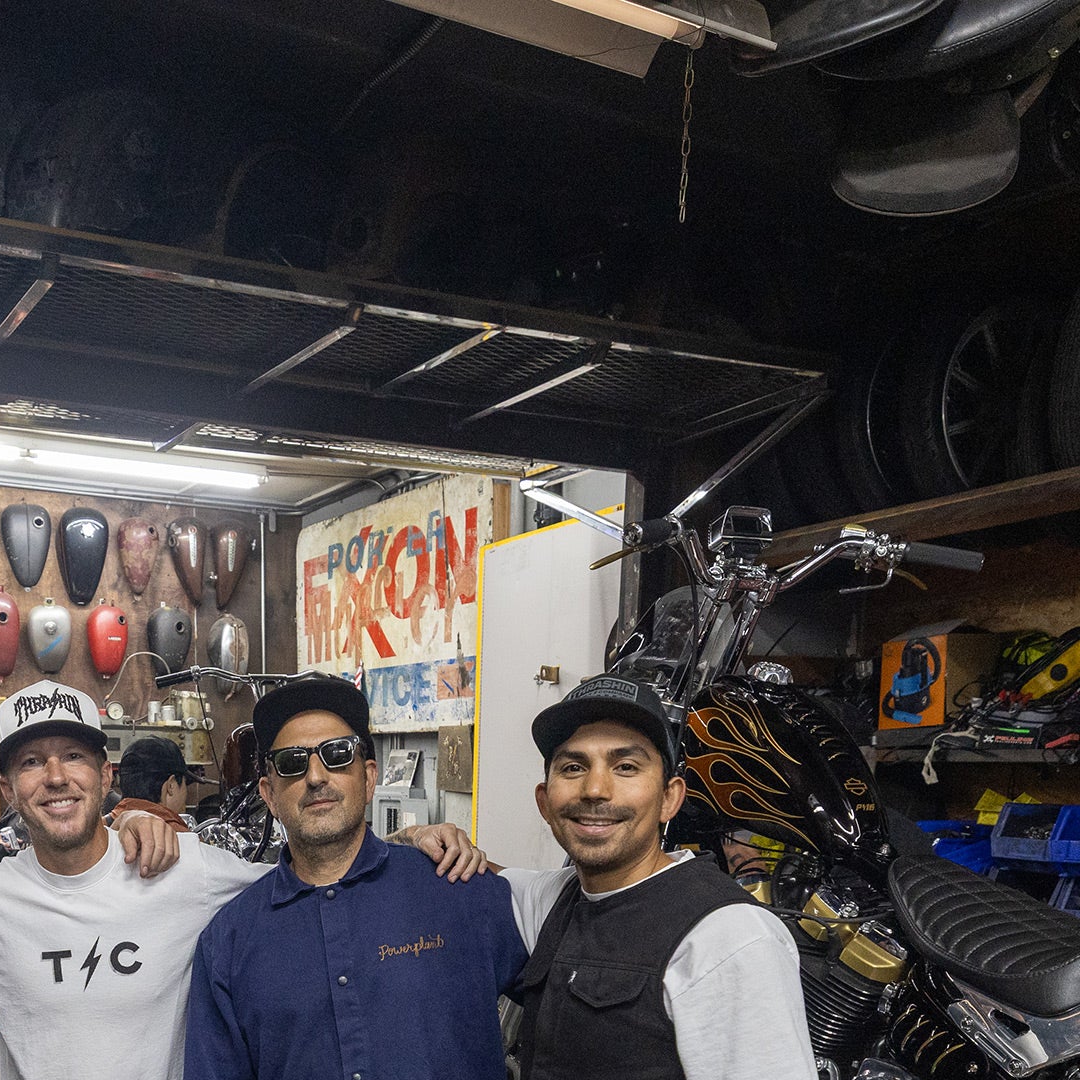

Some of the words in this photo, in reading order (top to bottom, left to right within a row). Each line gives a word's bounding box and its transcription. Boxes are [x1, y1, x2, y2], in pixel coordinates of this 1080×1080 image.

[341, 664, 433, 710] VICE
[572, 680, 636, 700] THRASHIN
[378, 933, 445, 962] Powerplant
